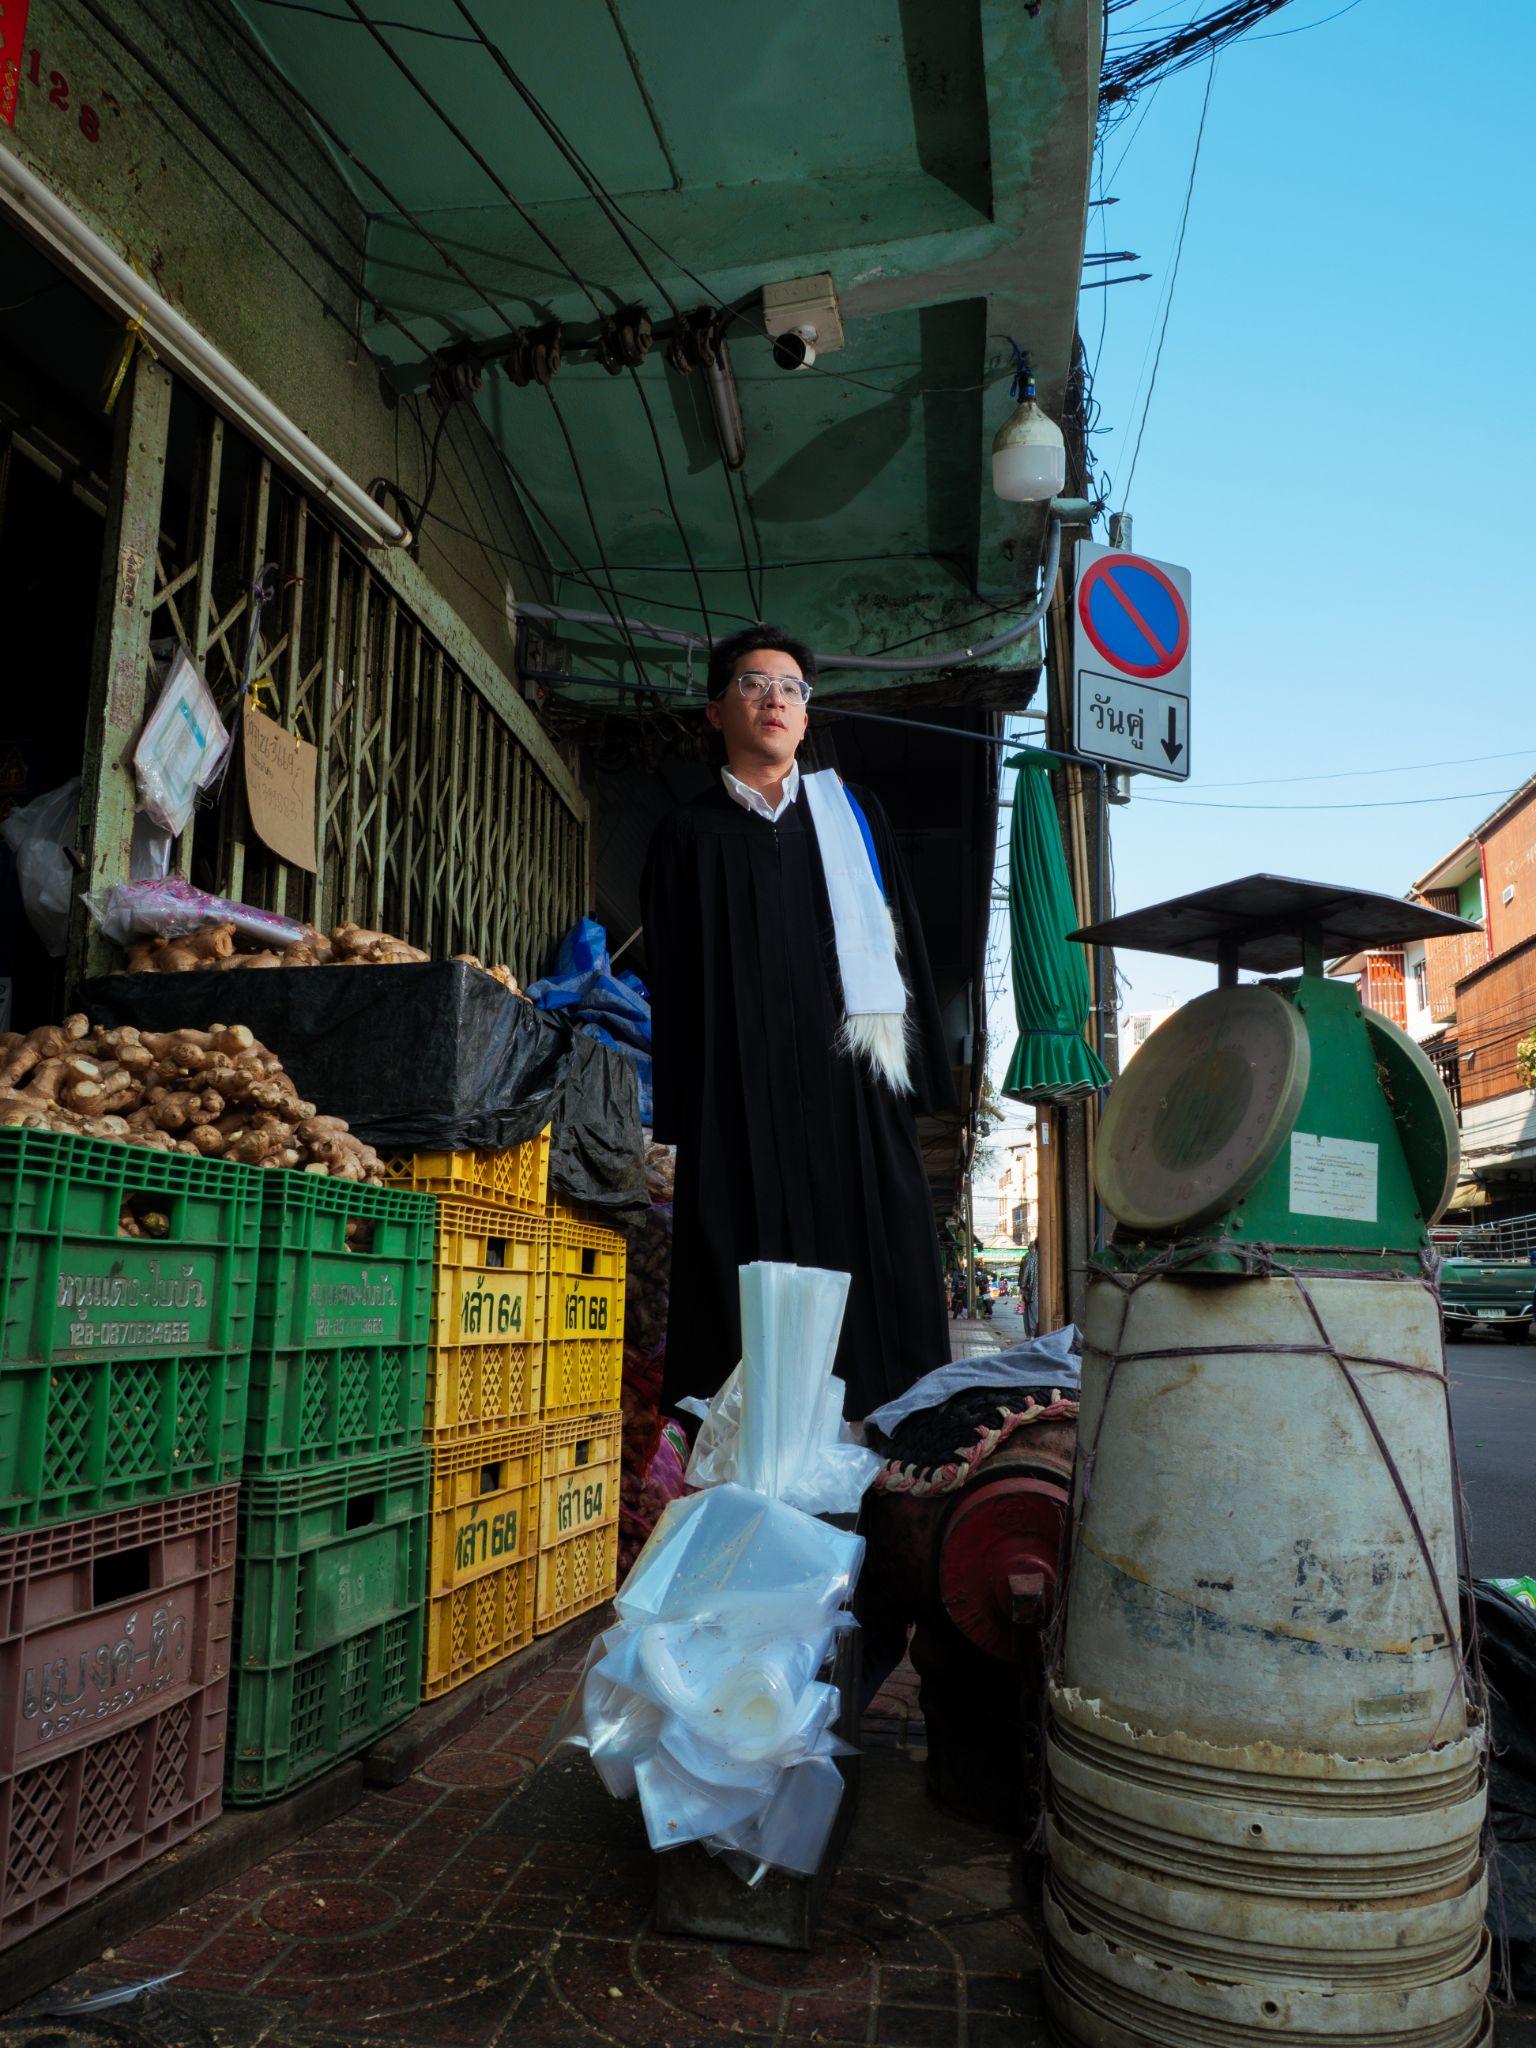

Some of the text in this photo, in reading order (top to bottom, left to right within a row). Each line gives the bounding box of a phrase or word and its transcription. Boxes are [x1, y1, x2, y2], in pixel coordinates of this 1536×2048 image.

[27, 49, 100, 142] 128
[1090, 693, 1144, 751] วันคู่
[498, 1293, 522, 1333] 64
[589, 1296, 608, 1331] 68
[584, 1482, 603, 1521] 64
[491, 1510, 517, 1557] 68
